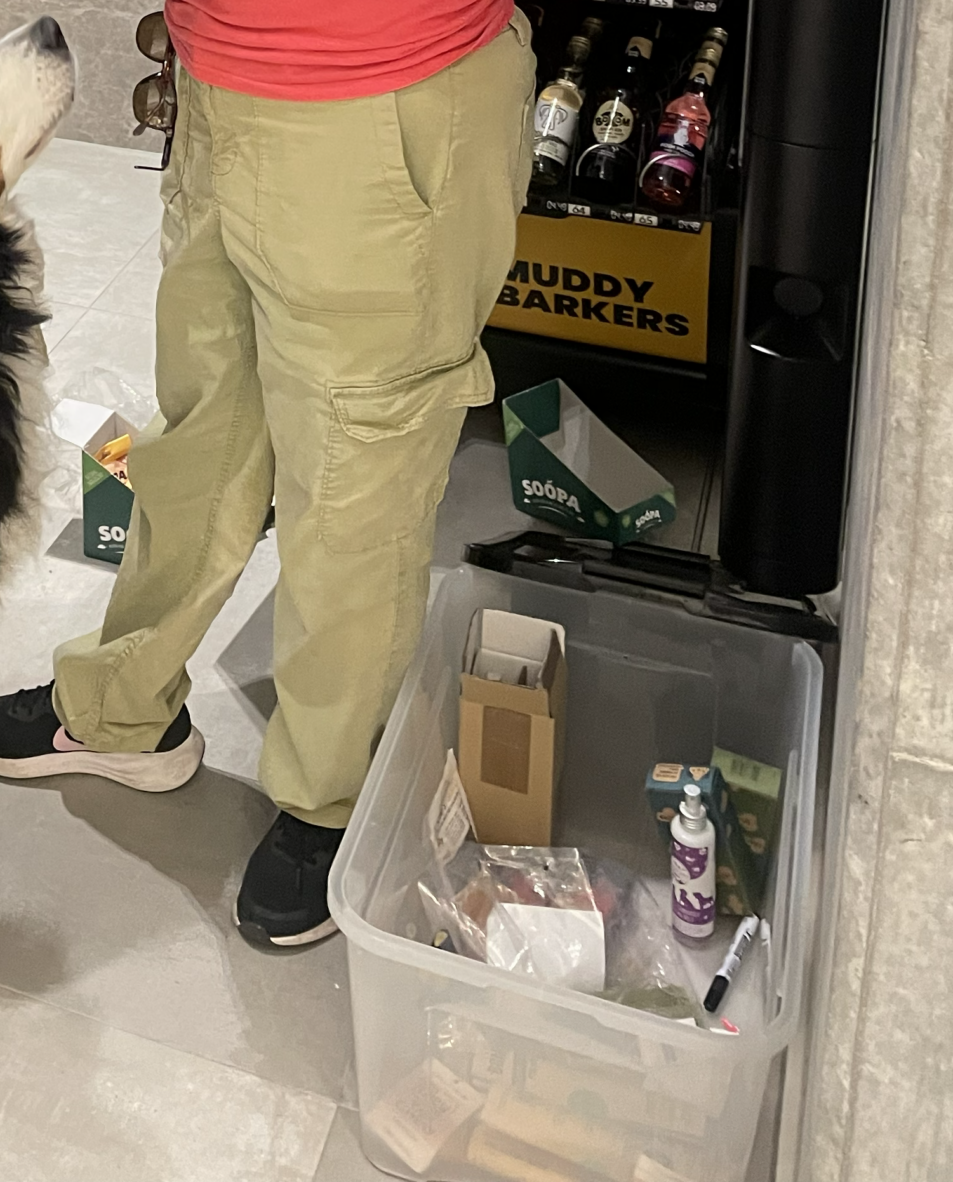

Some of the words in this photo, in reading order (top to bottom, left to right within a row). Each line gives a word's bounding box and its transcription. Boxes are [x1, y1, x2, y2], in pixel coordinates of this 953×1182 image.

[506, 259, 655, 304] MUDDY
[495, 284, 691, 337] BARKERS
[98, 525, 127, 542] SO
